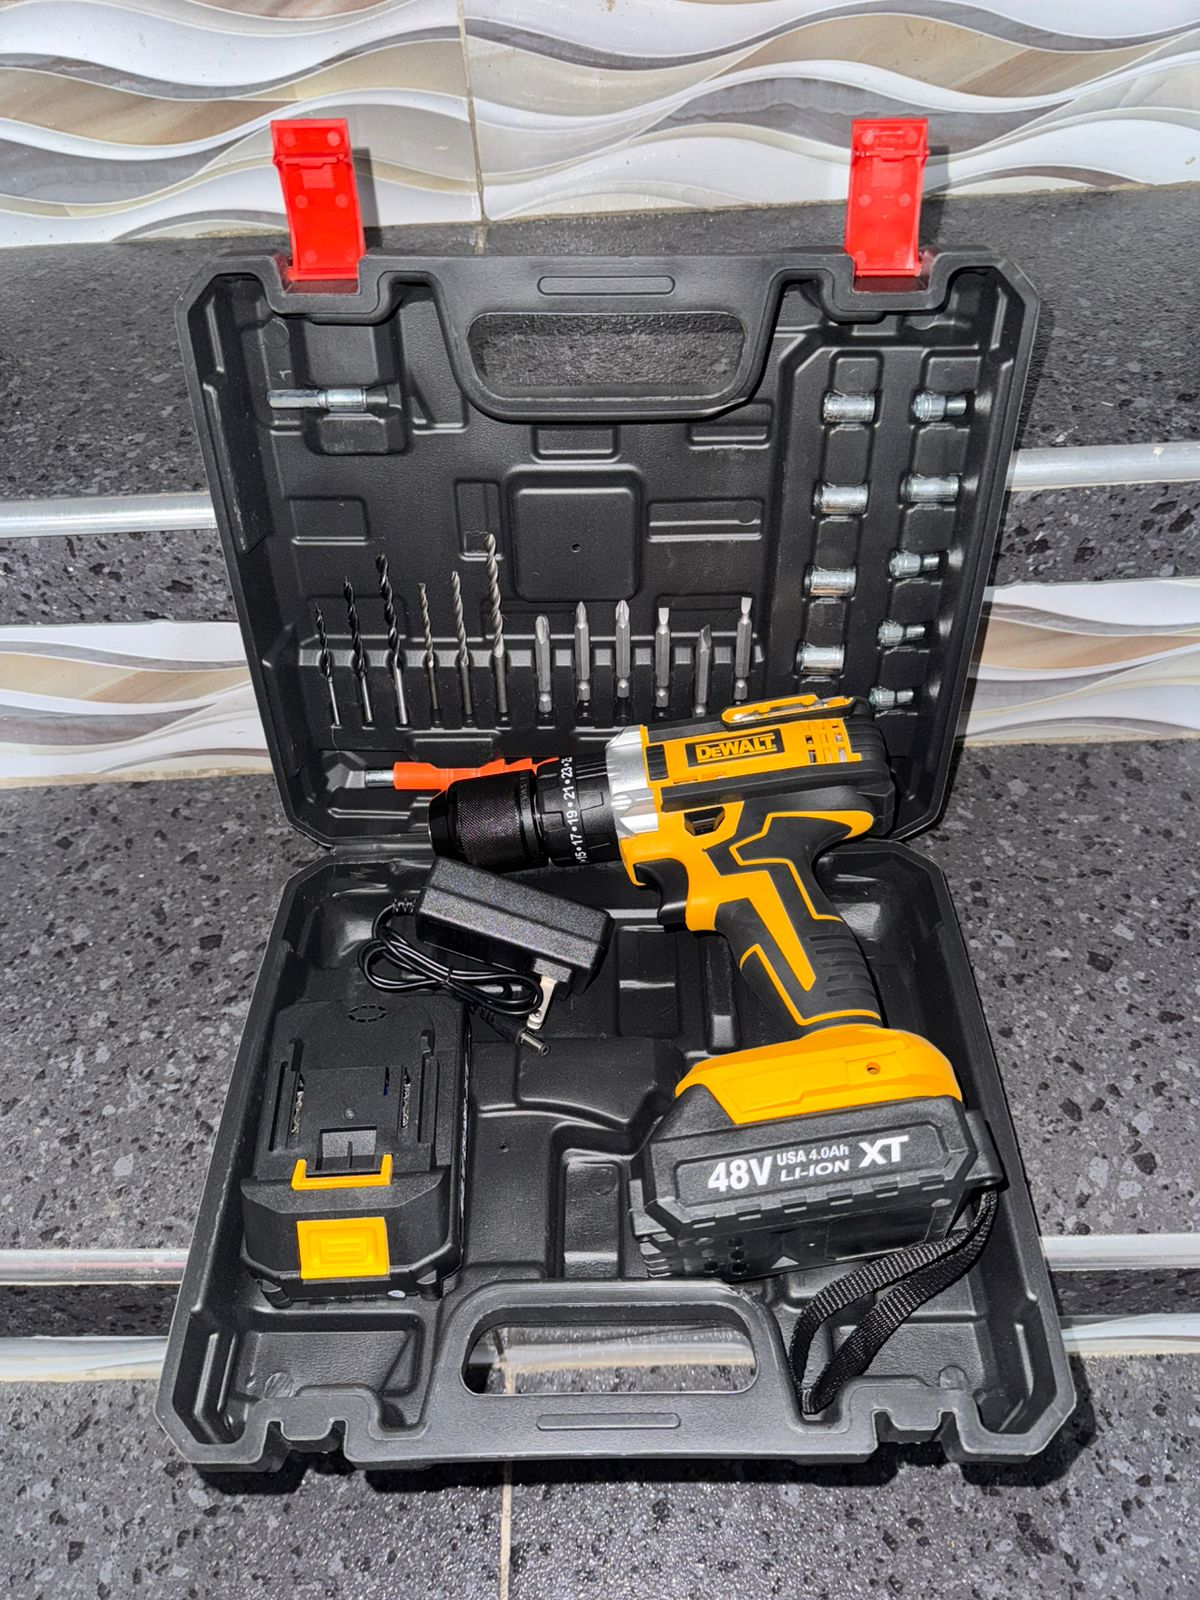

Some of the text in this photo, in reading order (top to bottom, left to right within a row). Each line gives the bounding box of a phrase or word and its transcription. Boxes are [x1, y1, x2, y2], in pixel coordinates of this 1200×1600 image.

[696, 733, 776, 762] DEWALT
[560, 766, 573, 779] 23
[562, 785, 575, 800] 21
[565, 810, 579, 825] 19
[569, 833, 583, 846] 17
[707, 1134, 910, 1192] 48V USA 4.0Ah XT
[779, 1159, 850, 1182] LI-ION
